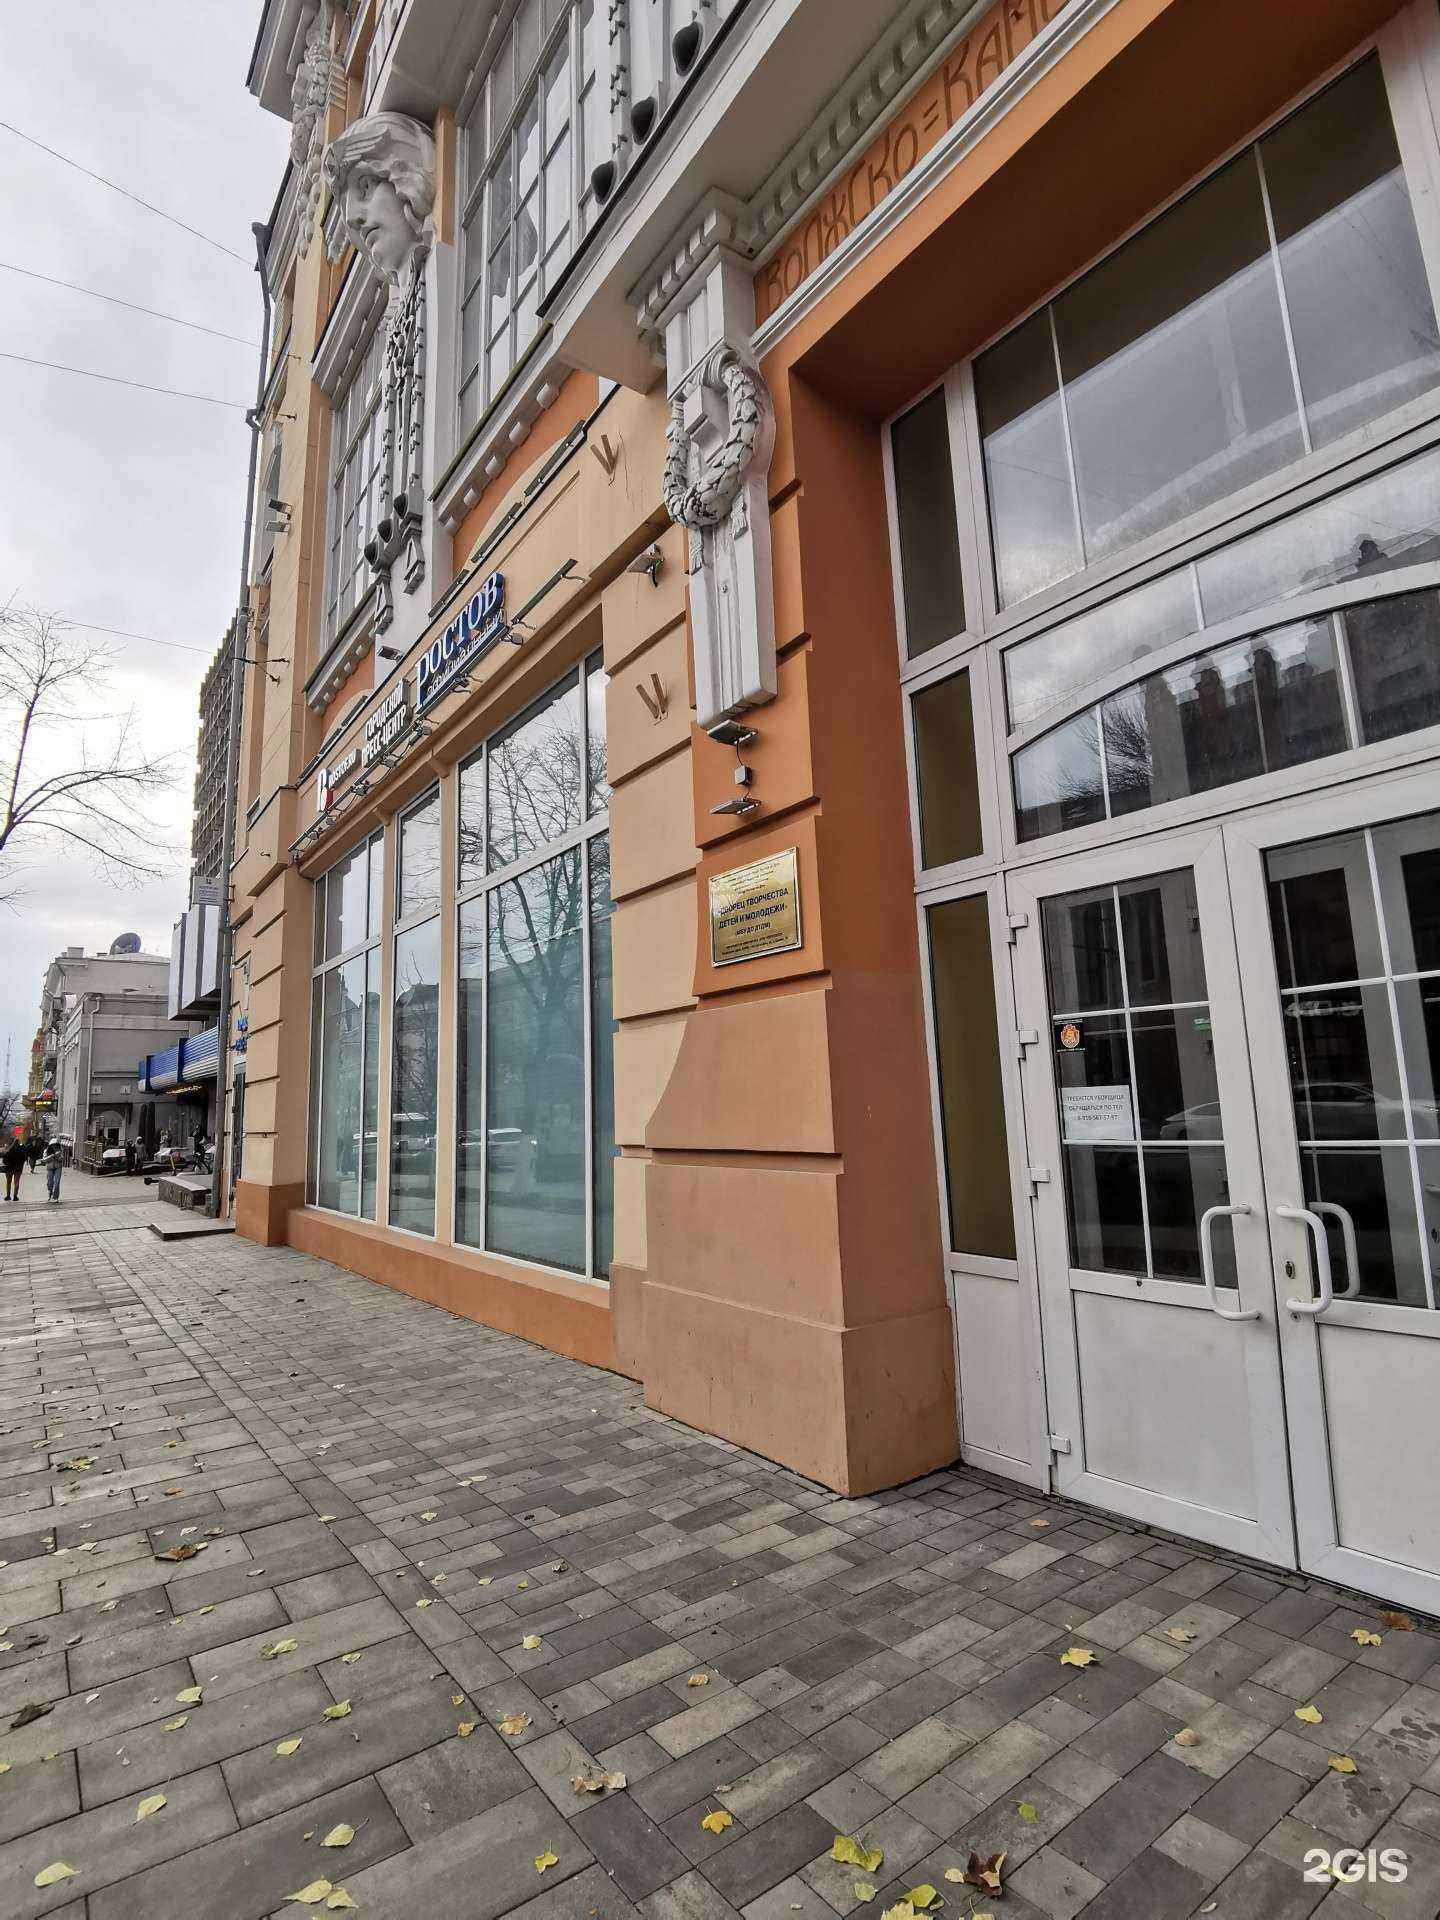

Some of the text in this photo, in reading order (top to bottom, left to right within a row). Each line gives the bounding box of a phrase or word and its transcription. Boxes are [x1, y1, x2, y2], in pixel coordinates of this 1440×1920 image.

[415, 571, 503, 710] РОСТОВ
[362, 704, 407, 767] ПРЕСС-ЦЕНТР
[746, 888, 789, 908] ТВОРЧЕСТВА
